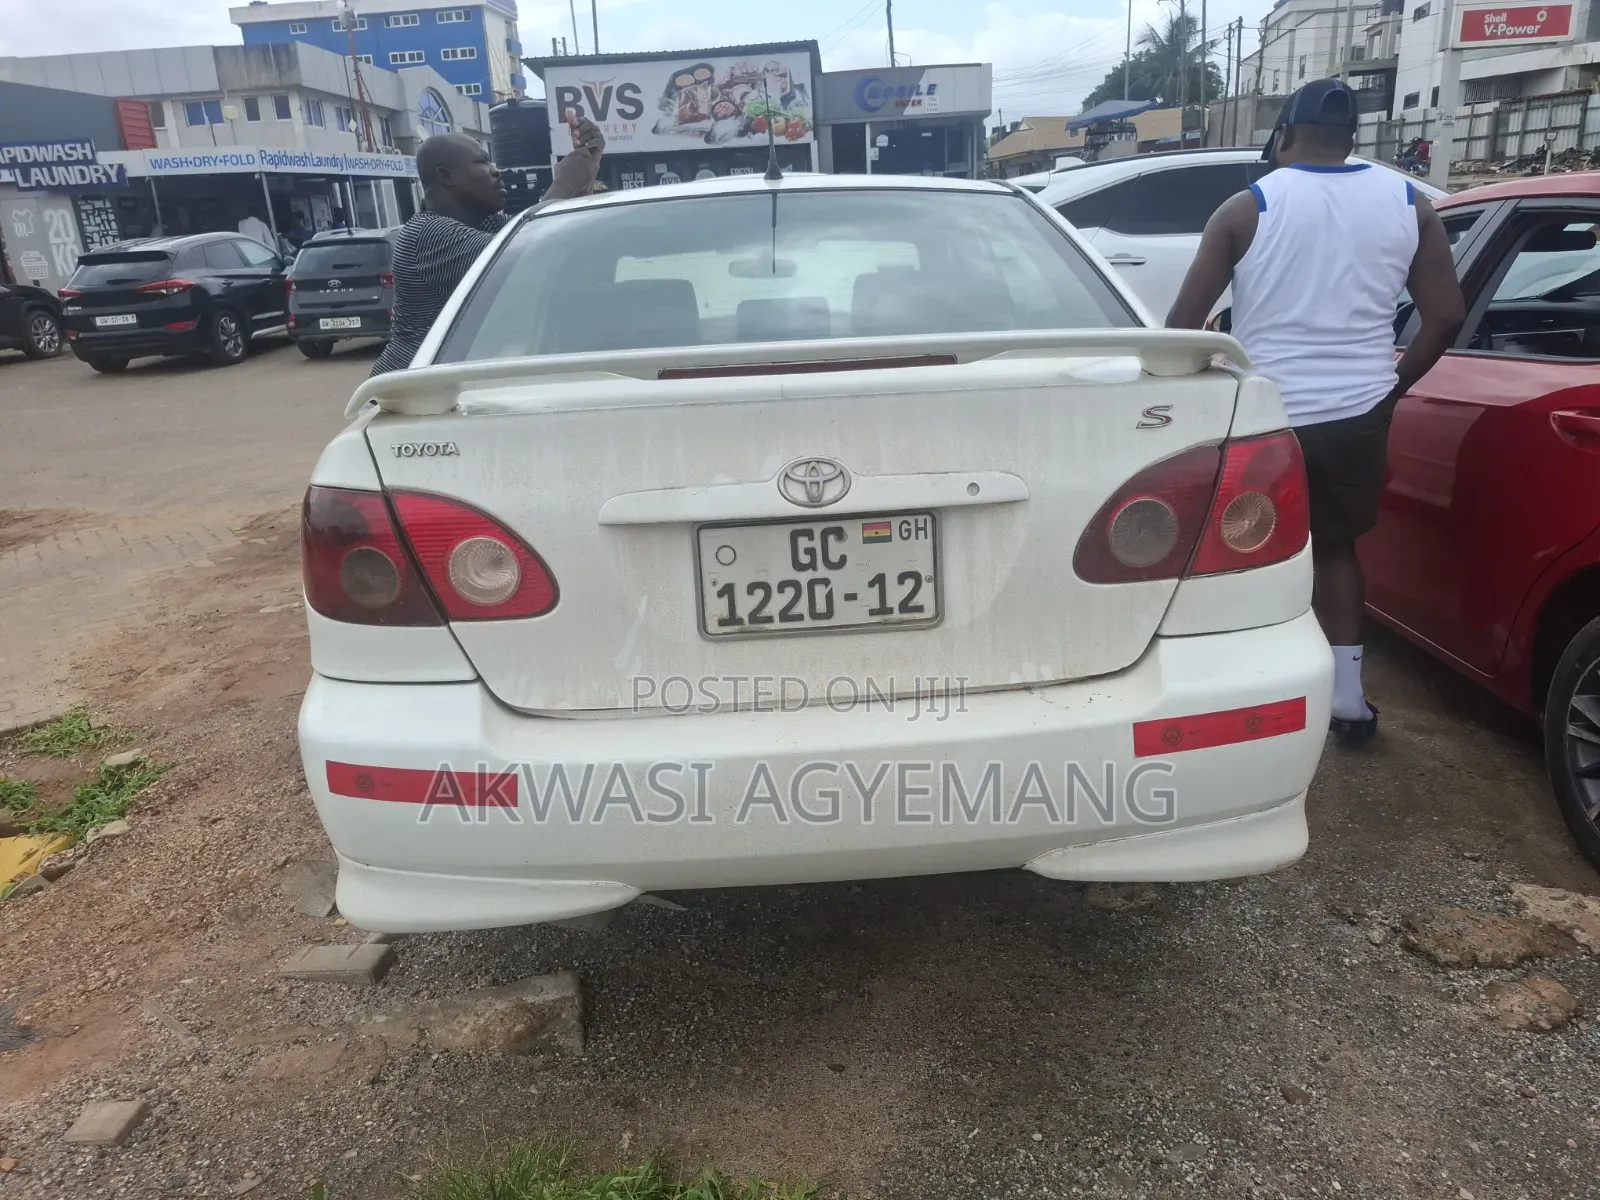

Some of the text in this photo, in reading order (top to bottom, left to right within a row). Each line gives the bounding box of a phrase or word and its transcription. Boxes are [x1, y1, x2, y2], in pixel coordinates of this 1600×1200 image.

[1483, 12, 1507, 24] Shell
[1483, 24, 1541, 37] V-Power
[555, 82, 644, 123] BVS
[14, 163, 119, 188] LAUNDRY
[44, 208, 76, 244] 20
[1135, 404, 1174, 430] S
[391, 442, 460, 458] TOYOTA
[790, 518, 929, 572] GC GH
